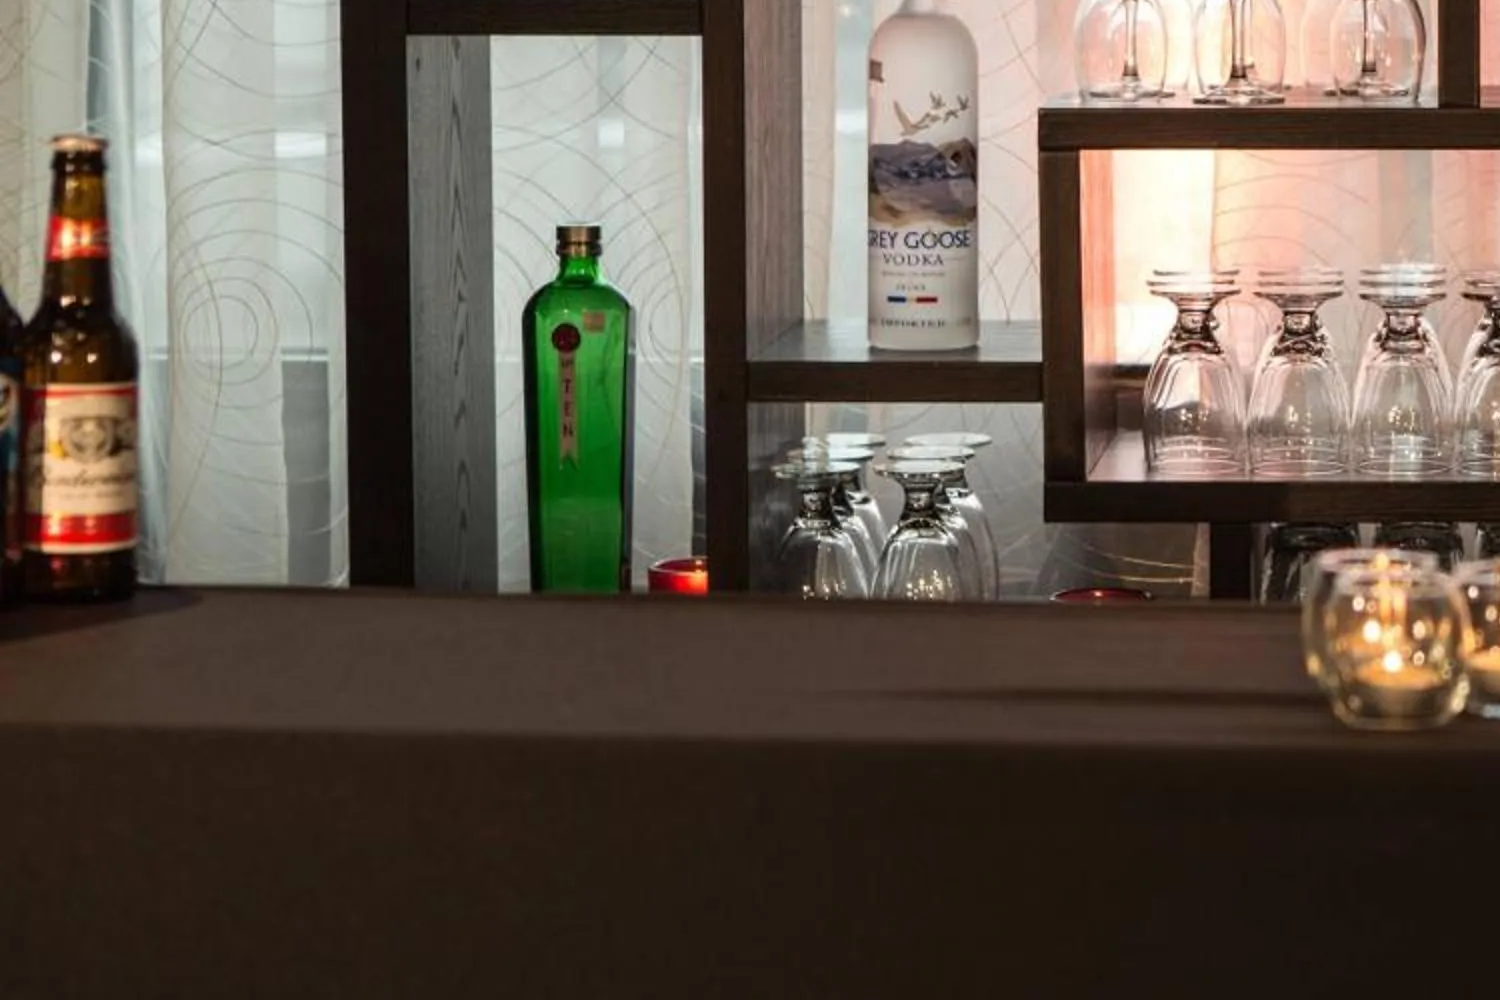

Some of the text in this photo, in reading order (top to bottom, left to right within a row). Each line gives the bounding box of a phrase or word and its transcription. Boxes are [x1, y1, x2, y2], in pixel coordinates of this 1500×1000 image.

[868, 230, 972, 249] REY GOOSE
[883, 252, 944, 267] VODKA
